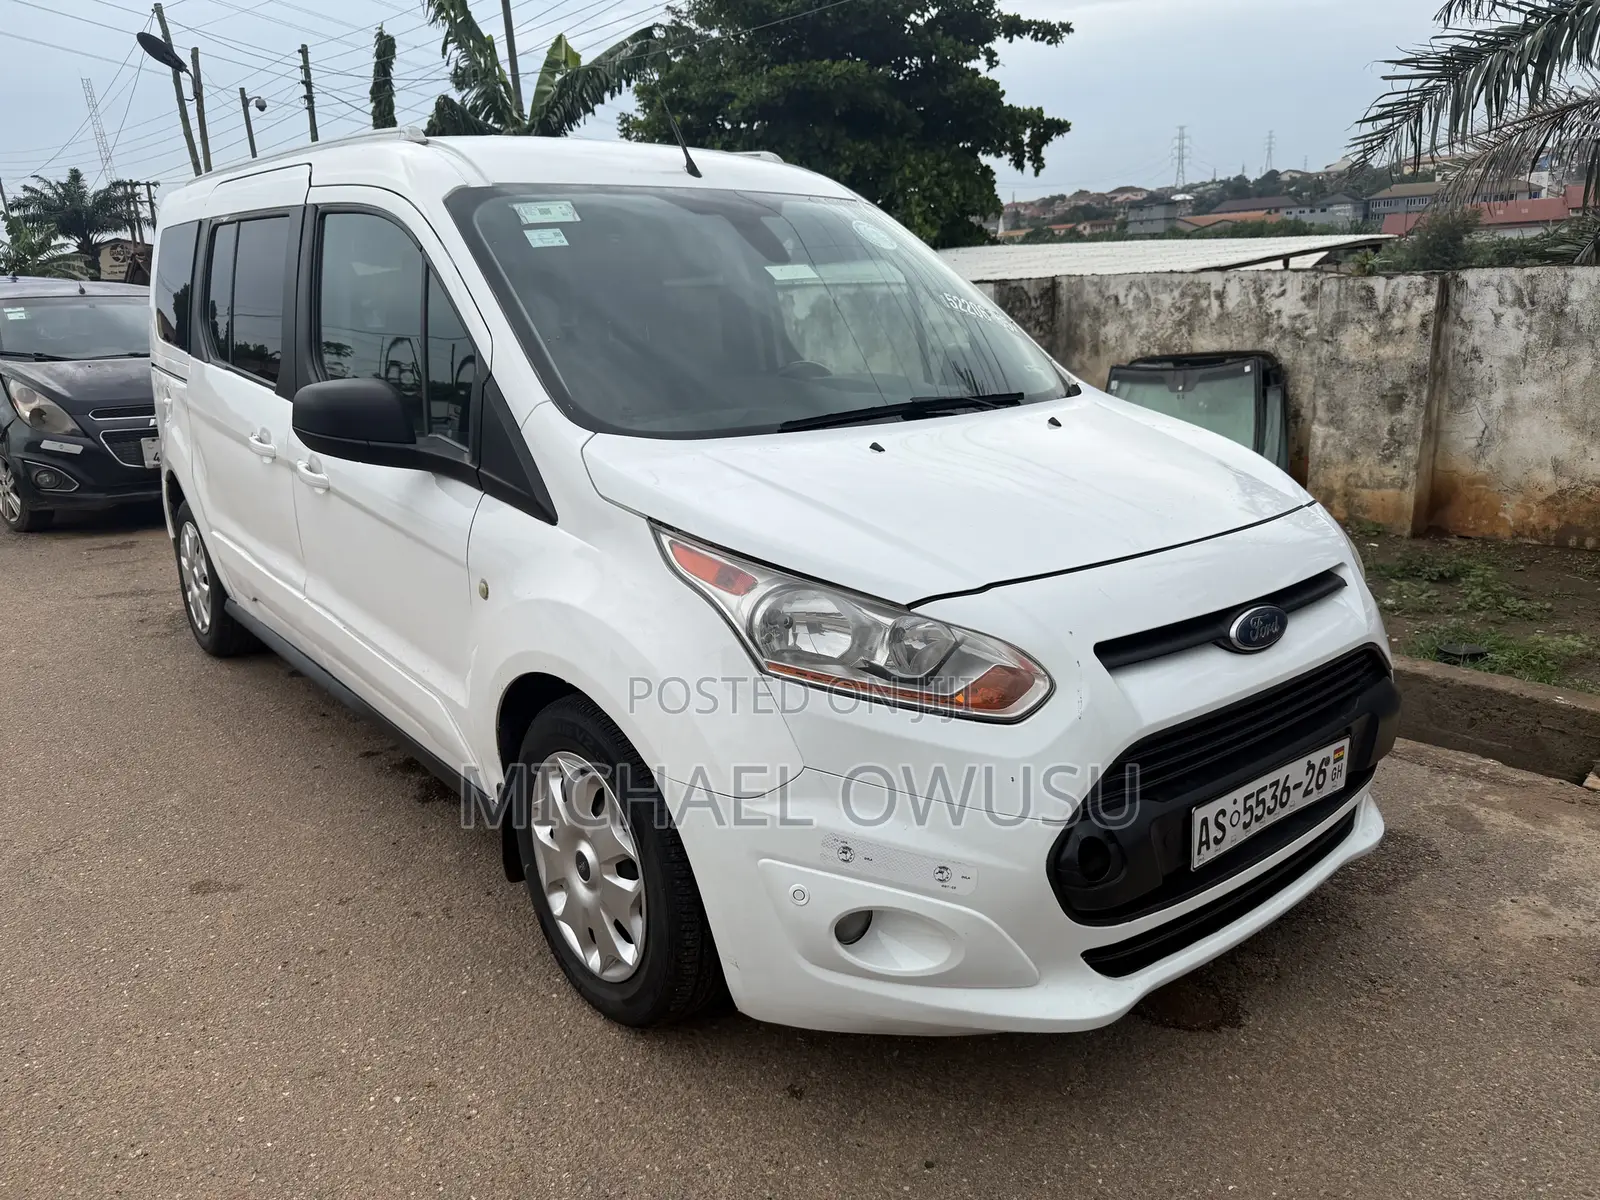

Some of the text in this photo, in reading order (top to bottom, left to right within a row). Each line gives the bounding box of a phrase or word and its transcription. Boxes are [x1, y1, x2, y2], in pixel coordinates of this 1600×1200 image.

[1249, 613, 1280, 641] Ford
[1331, 763, 1343, 782] GH
[1197, 756, 1328, 856] AS 5536-26
